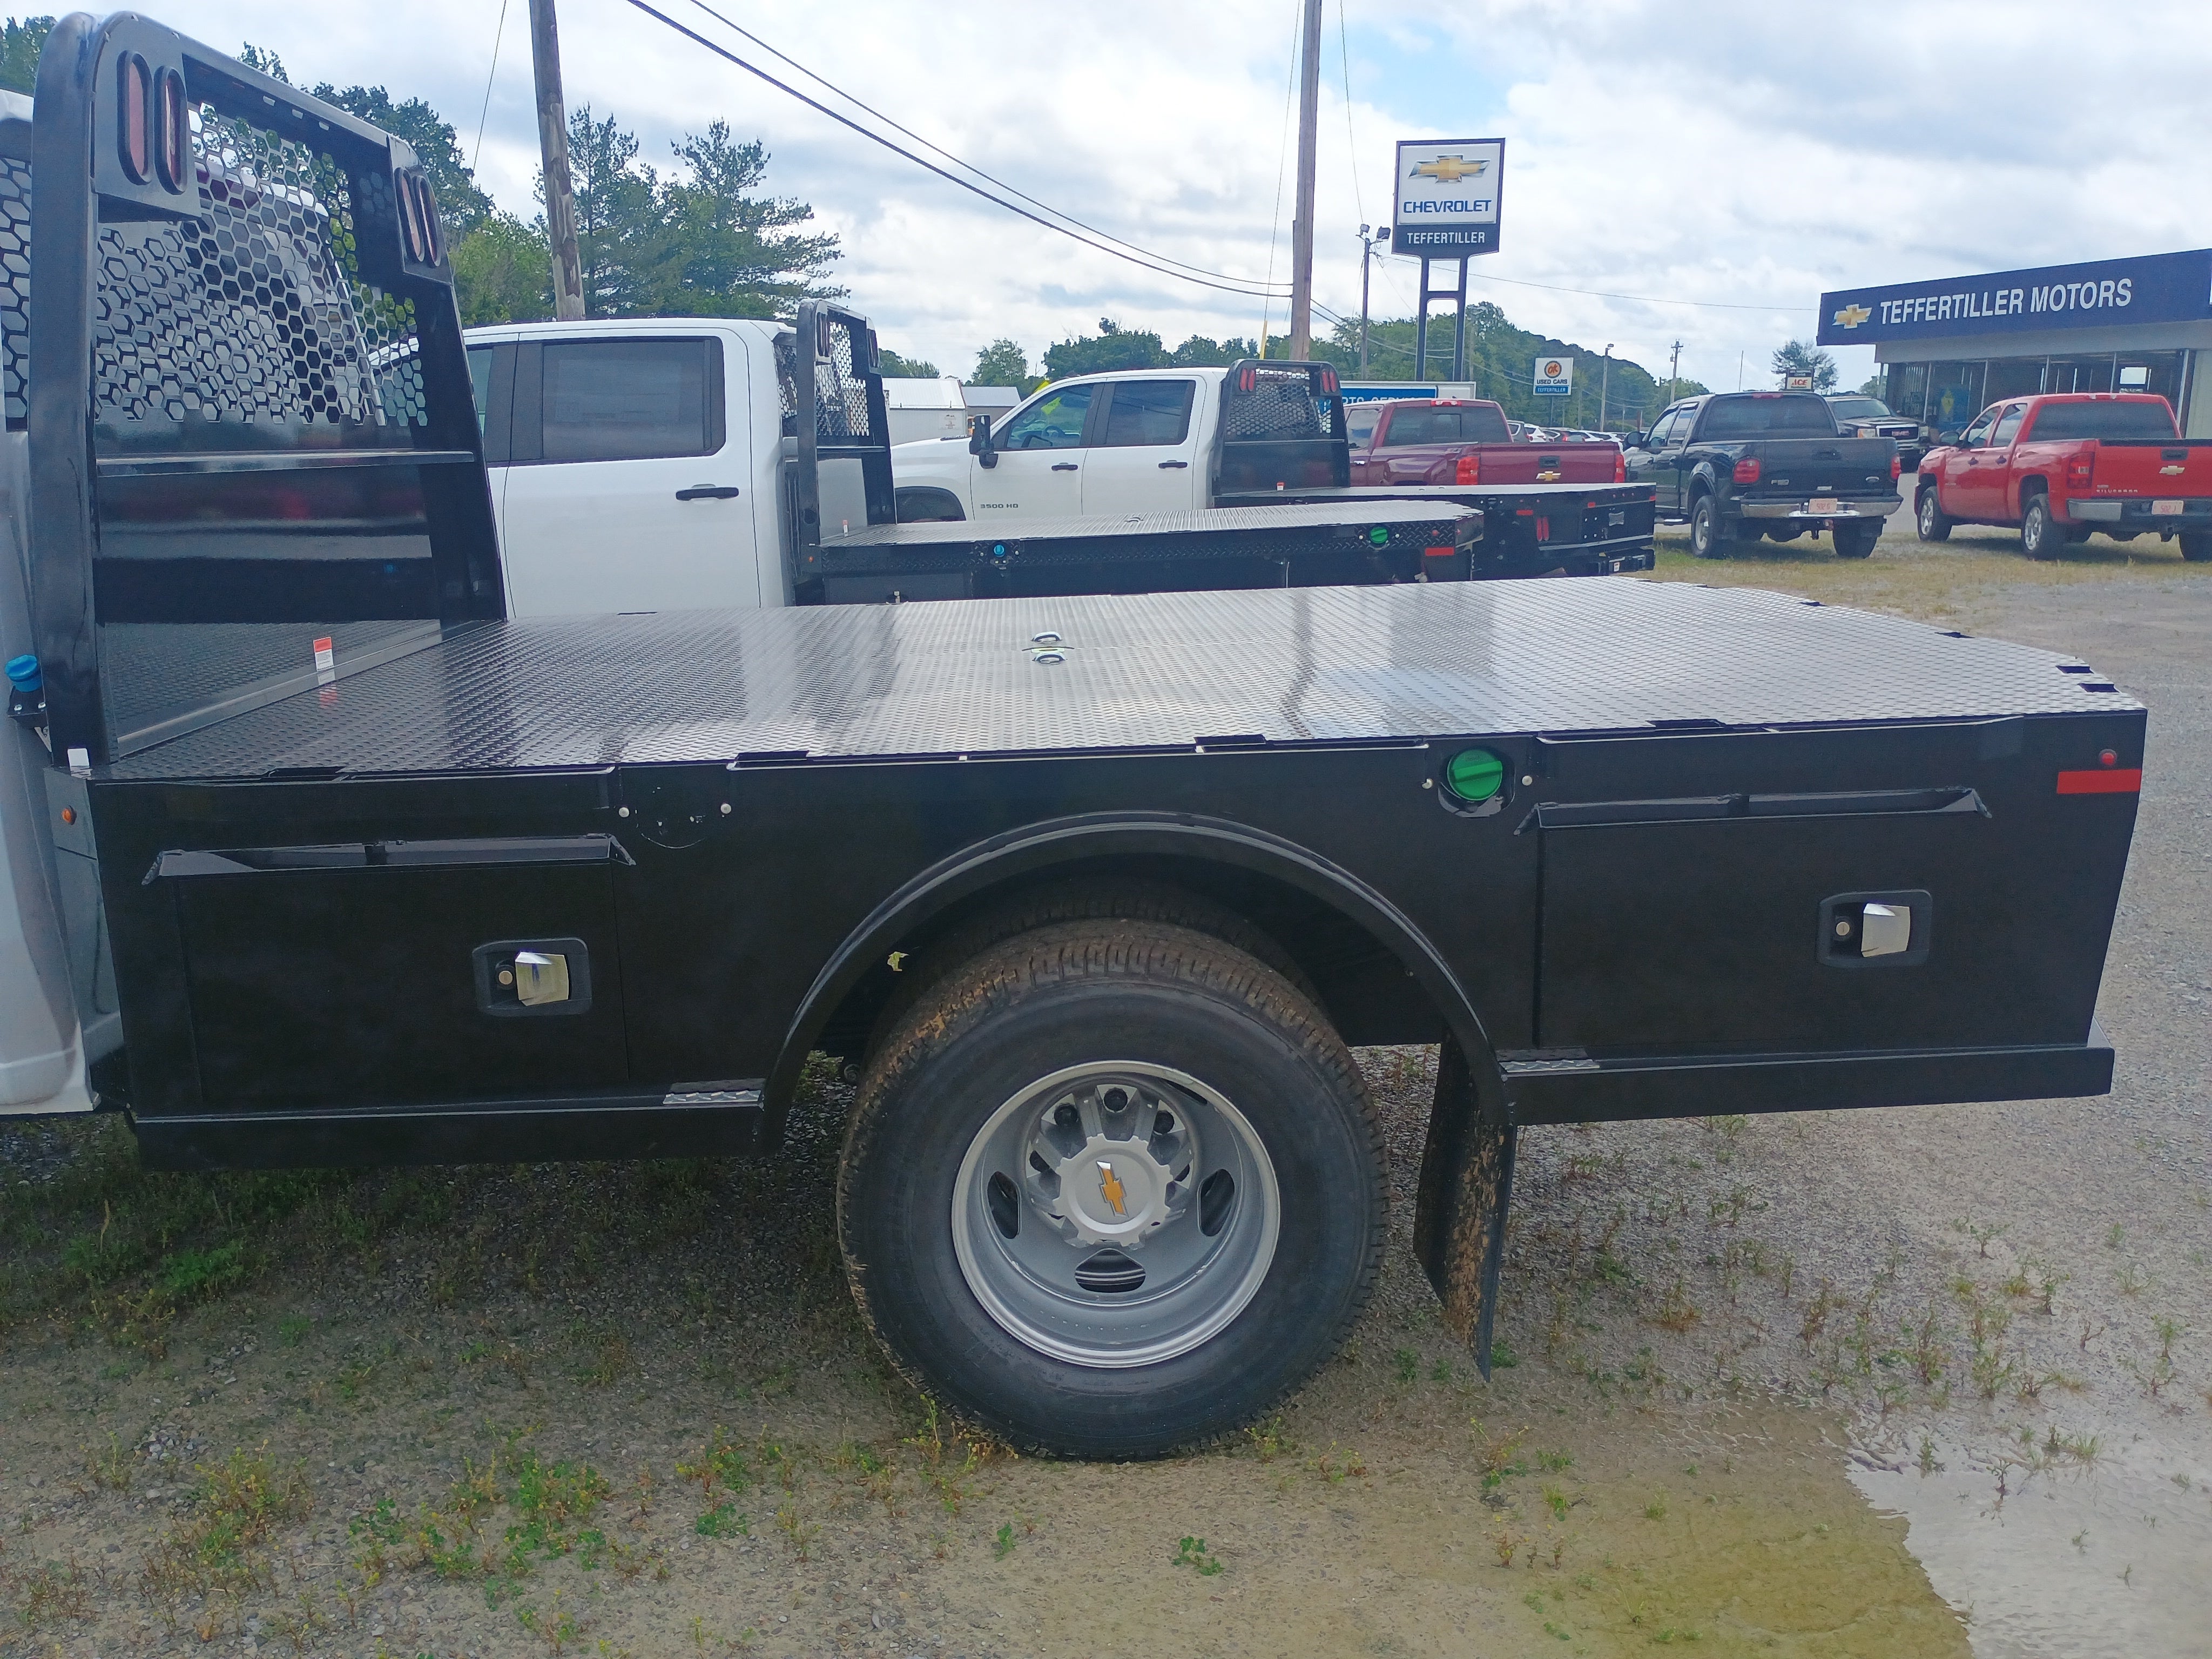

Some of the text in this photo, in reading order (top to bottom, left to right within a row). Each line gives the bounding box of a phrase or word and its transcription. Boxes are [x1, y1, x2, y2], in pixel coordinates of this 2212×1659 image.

[1404, 200, 1492, 213] CHEVROLET
[1407, 232, 1485, 244] TEFFERTILLER
[1880, 278, 2132, 325] TEFFERTILLER MOTORS
